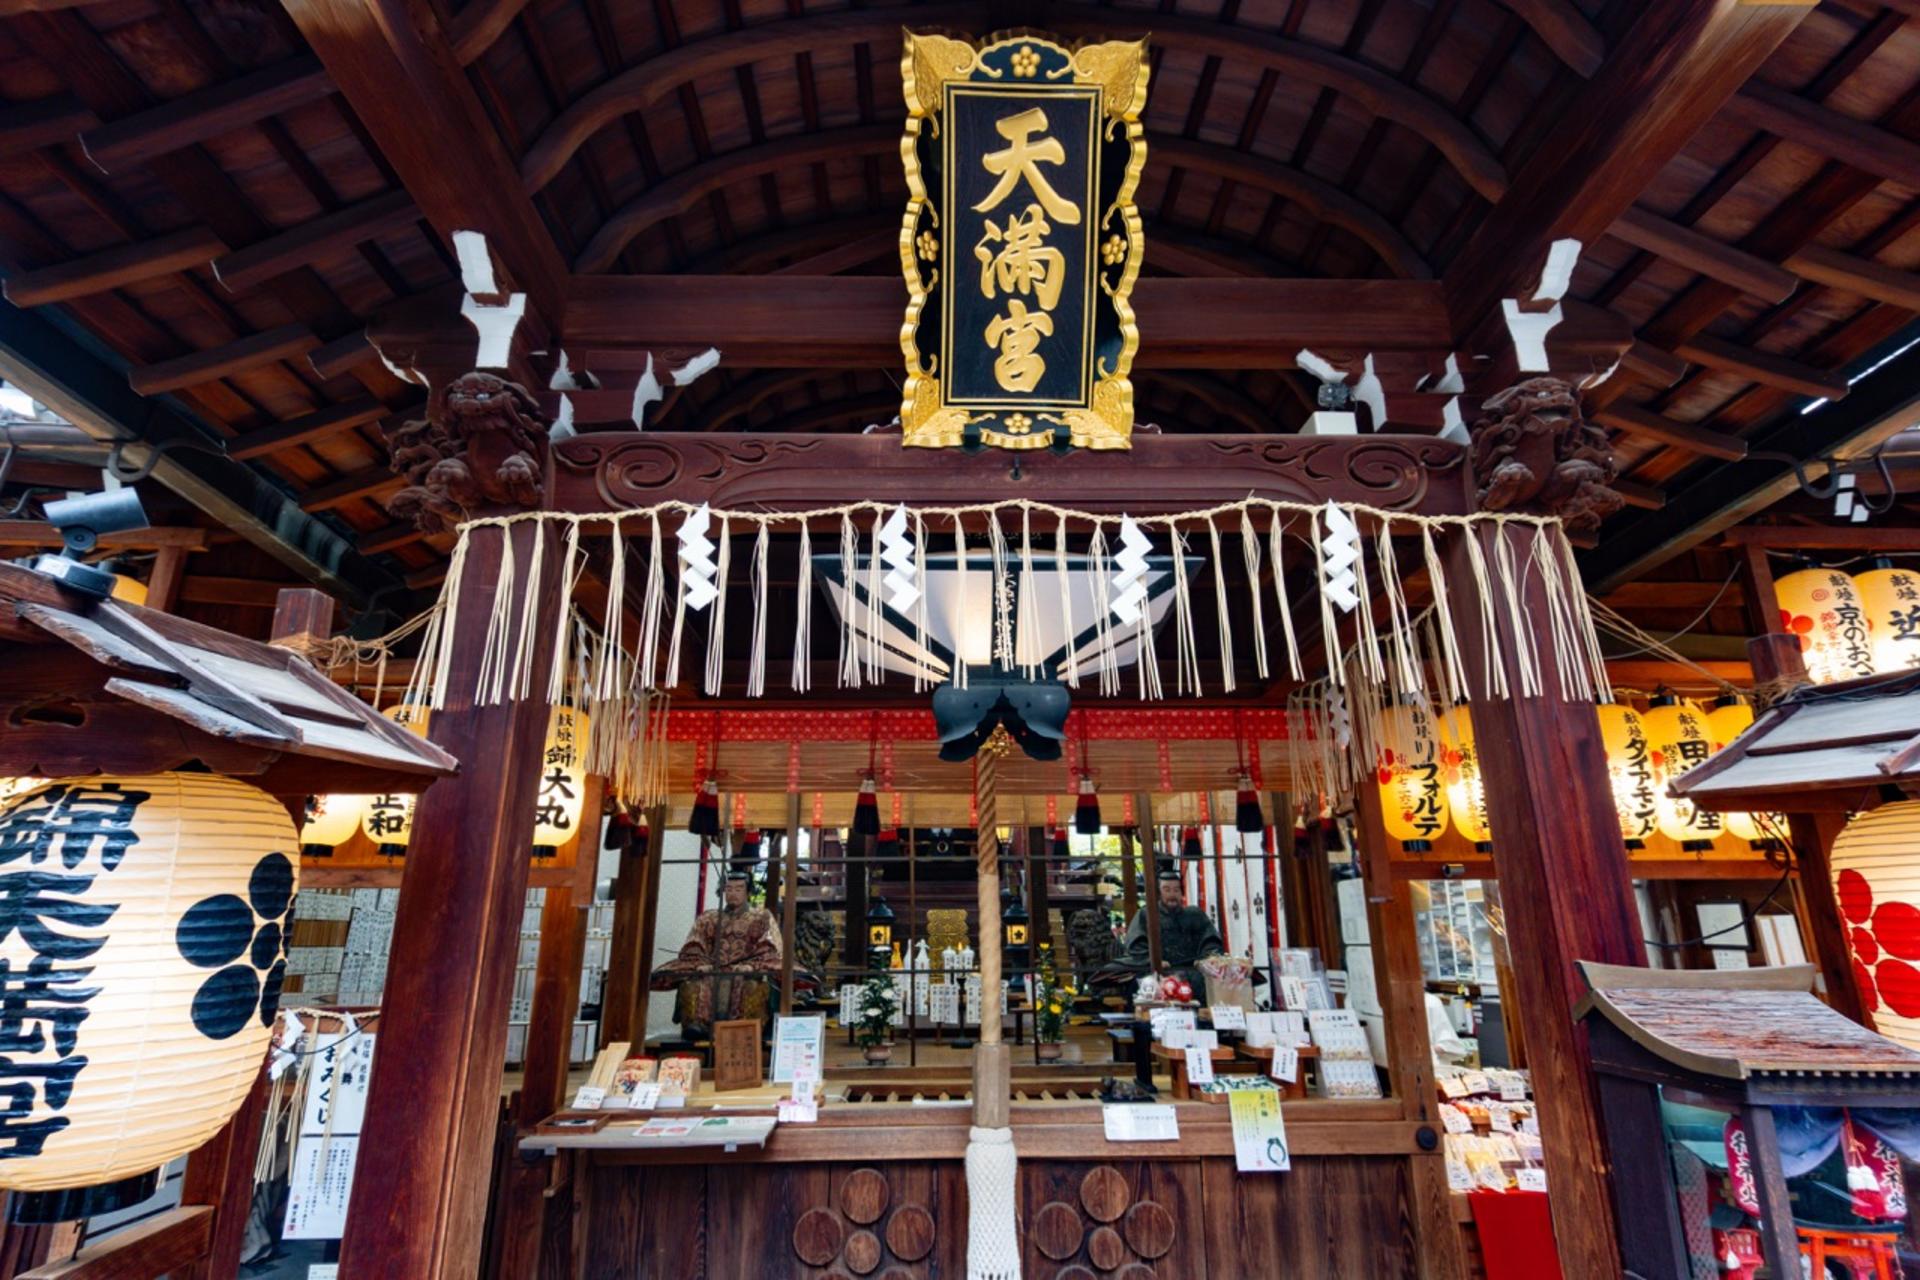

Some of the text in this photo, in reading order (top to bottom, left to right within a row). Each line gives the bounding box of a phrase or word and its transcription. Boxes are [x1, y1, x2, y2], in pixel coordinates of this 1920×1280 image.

[971, 107, 1081, 393] 天満宮
[1833, 602, 1876, 676] 京のおへ
[1410, 740, 1443, 836] リフォルテ
[1677, 739, 1721, 830] 田屋
